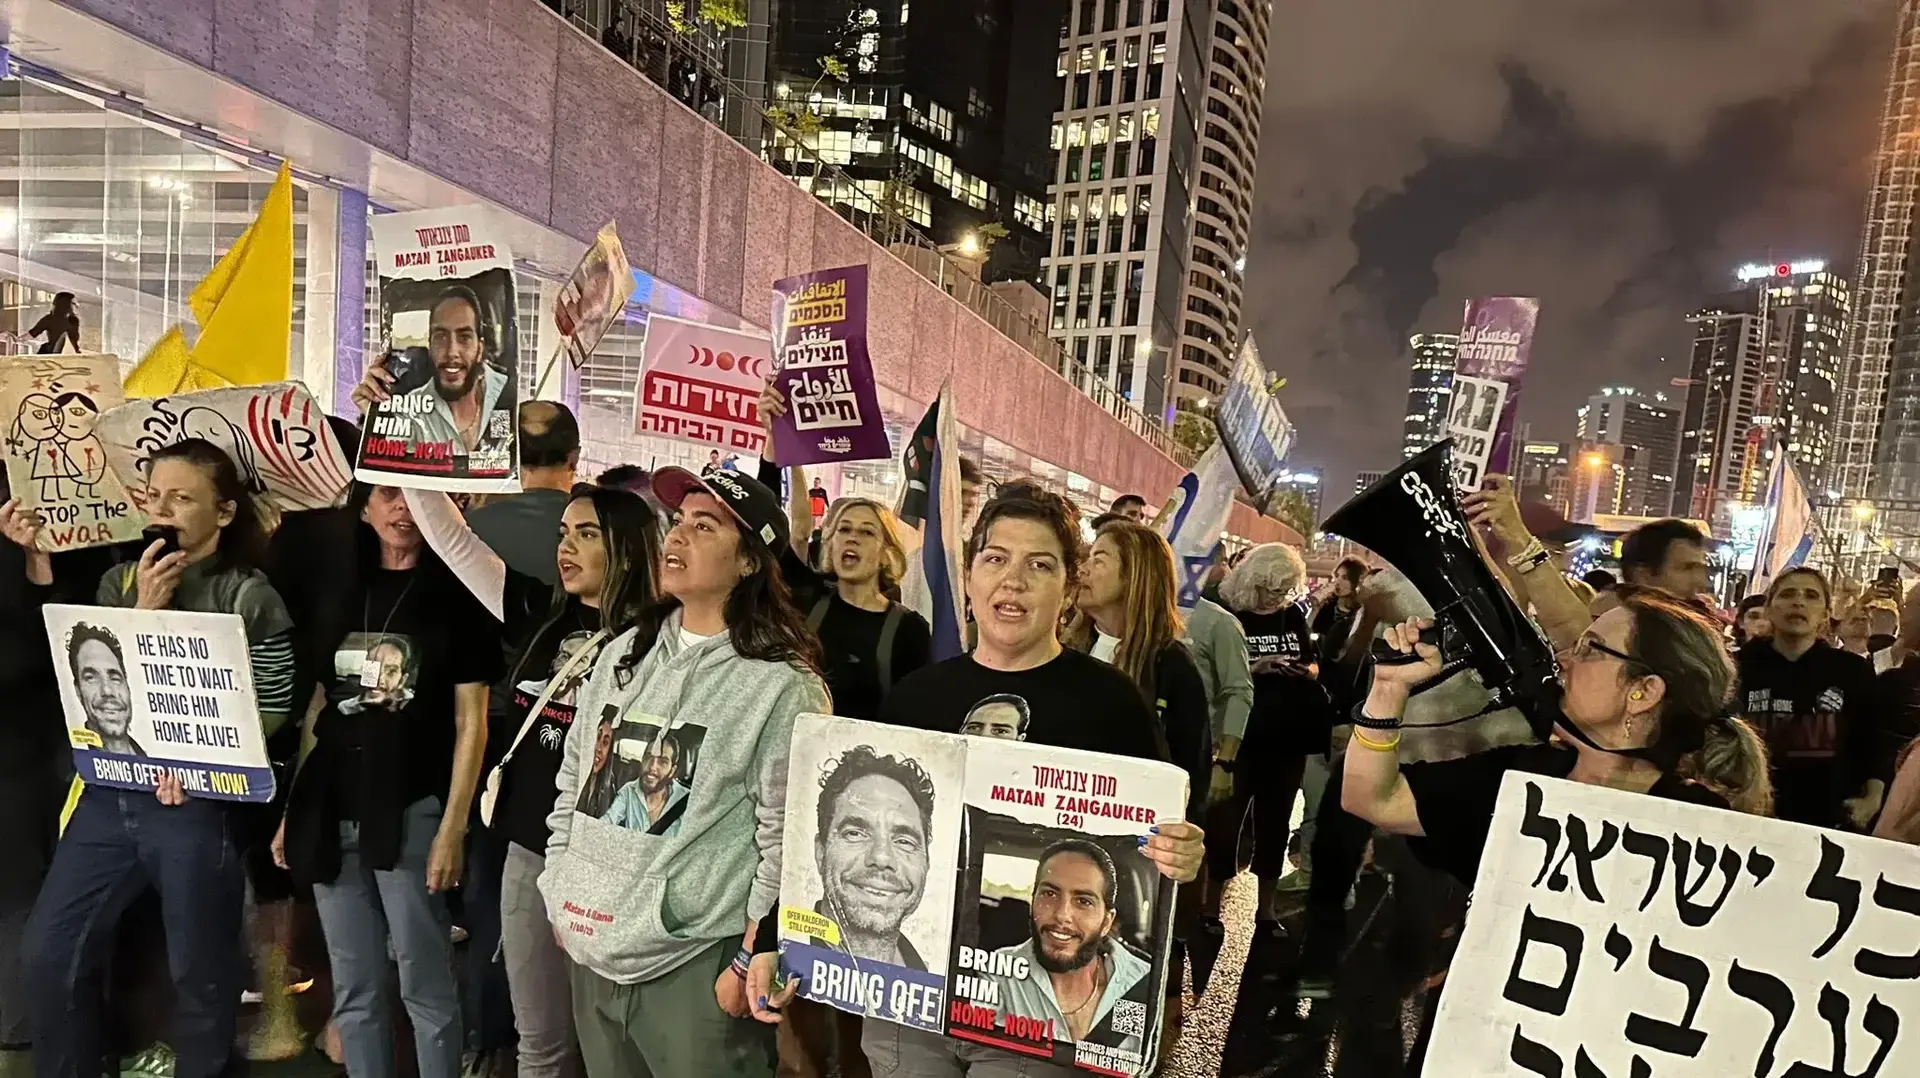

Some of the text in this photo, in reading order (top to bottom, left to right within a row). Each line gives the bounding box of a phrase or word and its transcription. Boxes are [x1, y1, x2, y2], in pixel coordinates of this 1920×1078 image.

[395, 244, 496, 268] MATAN ZANGAUKER
[439, 265, 457, 277] (24)
[789, 303, 843, 323] הסכמים
[799, 326, 831, 345] تنقذ
[788, 345, 844, 364] מצילים
[378, 394, 435, 414] BRING
[797, 400, 857, 423] חיים
[373, 416, 412, 437] HIM
[641, 411, 724, 443] הביתה
[366, 437, 454, 464] HOME NOW!
[38, 499, 128, 526] STOP The
[136, 634, 209, 660] HE HAS NO
[141, 663, 239, 691] TIME TO WAIT.
[147, 692, 220, 719] BRING HIM
[152, 720, 241, 749] HOME ALIVE!
[93, 757, 133, 783] BRING
[210, 769, 250, 796] NOW!
[1033, 765, 1117, 798] מתן צנגאוקר
[991, 785, 1156, 825] MATAN ZANGAUKER
[1056, 812, 1084, 829] (24)
[1520, 780, 1776, 928] ישראל
[786, 910, 830, 928] OFER KALDERON
[788, 921, 826, 938] STILL CAPTIVE
[958, 945, 1030, 980] BRING
[811, 960, 885, 1011] BRING
[955, 975, 1000, 1005] HIM
[1502, 902, 1900, 1078] ערבים
[950, 1000, 1054, 1050] HOME NOW!
[1075, 1049, 1113, 1070] FAMILIES
[1076, 1039, 1106, 1055] HOSTAGES
